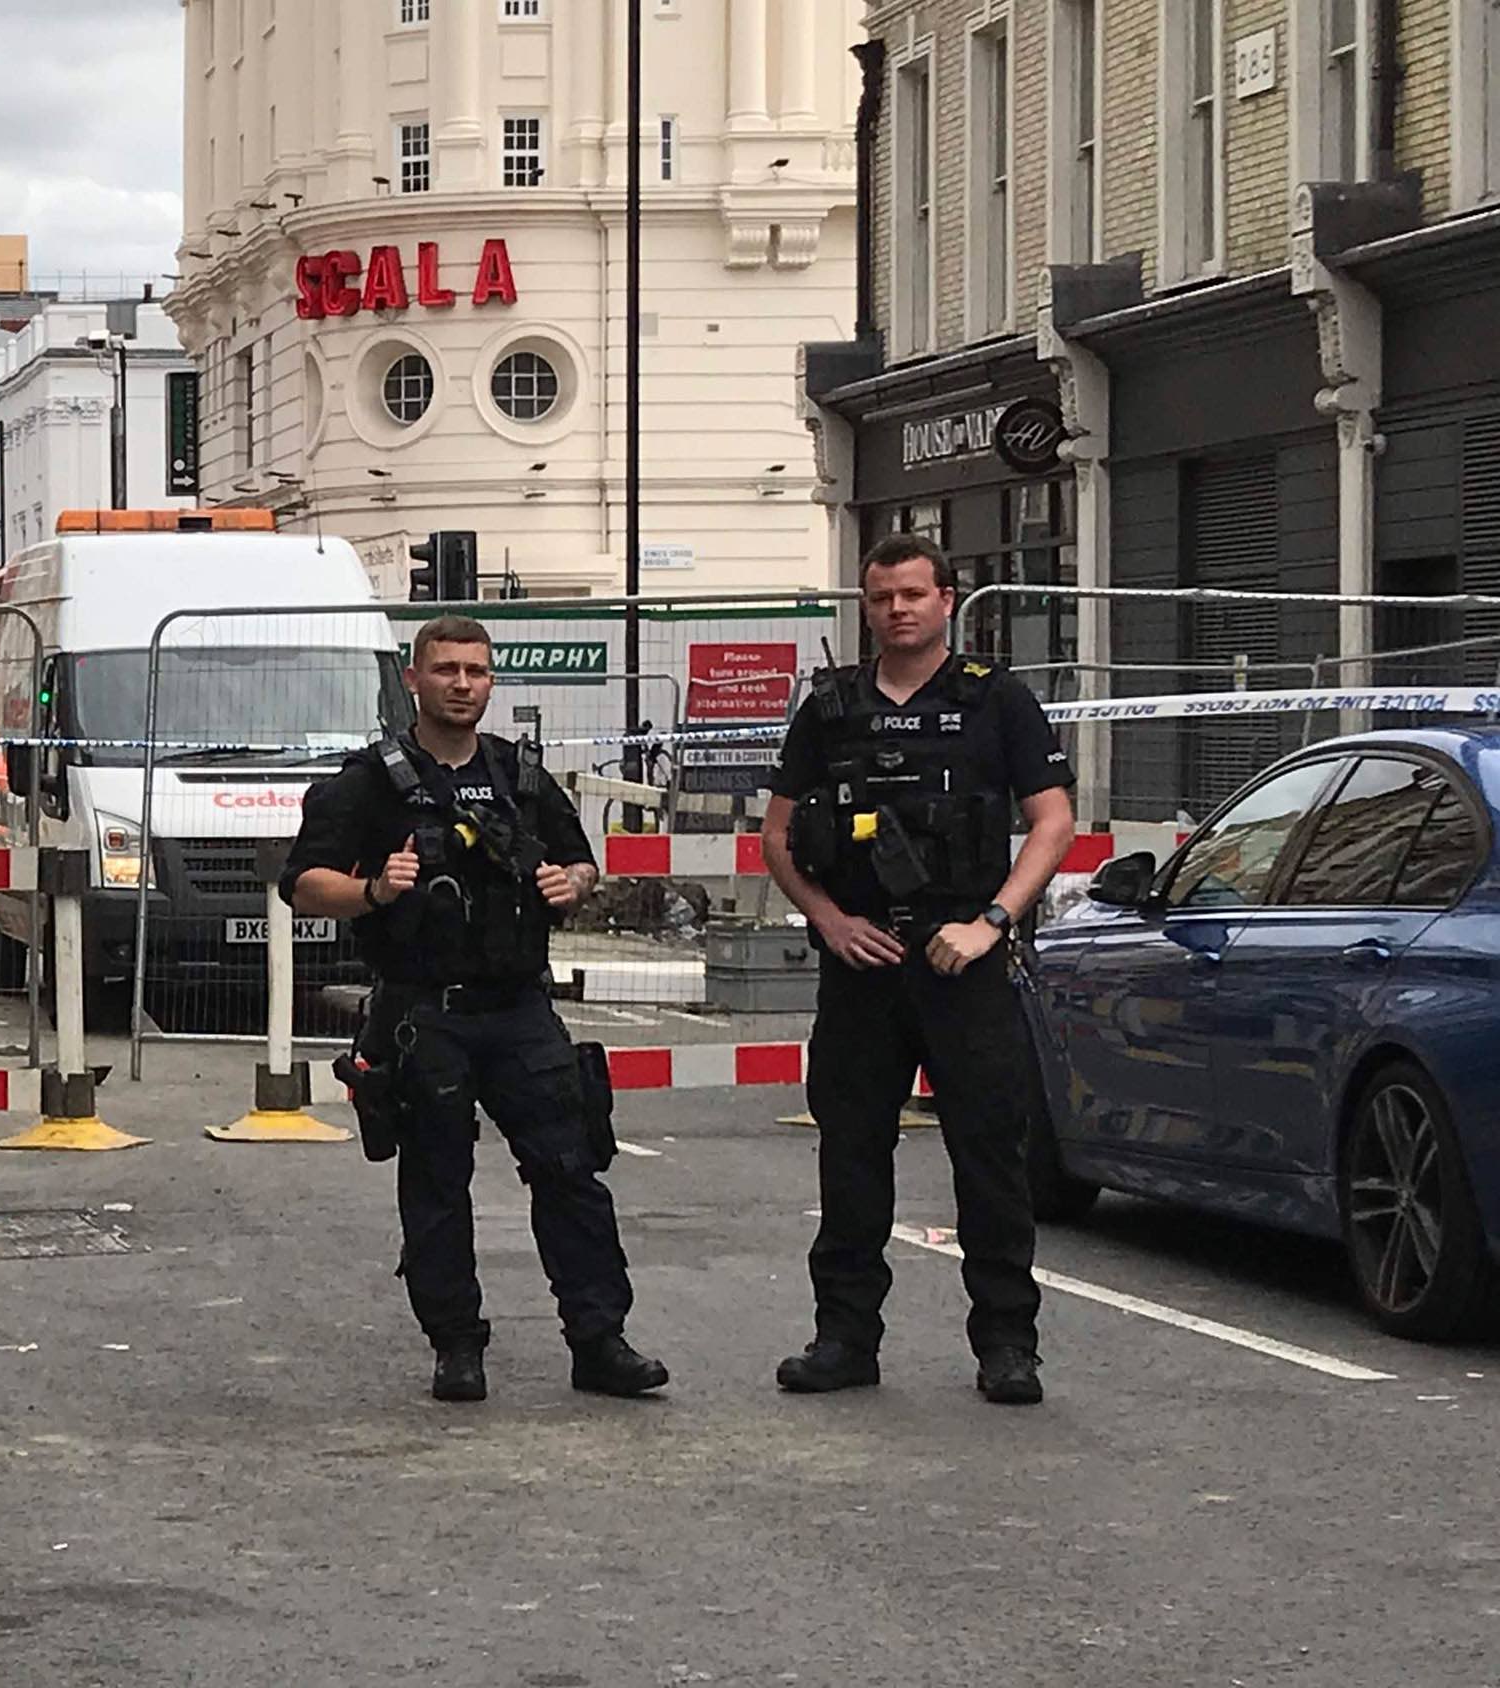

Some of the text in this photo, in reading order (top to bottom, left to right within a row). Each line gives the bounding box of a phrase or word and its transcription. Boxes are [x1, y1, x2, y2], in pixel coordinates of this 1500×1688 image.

[296, 239, 517, 319] SCALA
[902, 419, 952, 463] HOUSE
[491, 647, 603, 668] MURPHY
[884, 716, 921, 730] POLICE
[459, 786, 495, 801] POLICE
